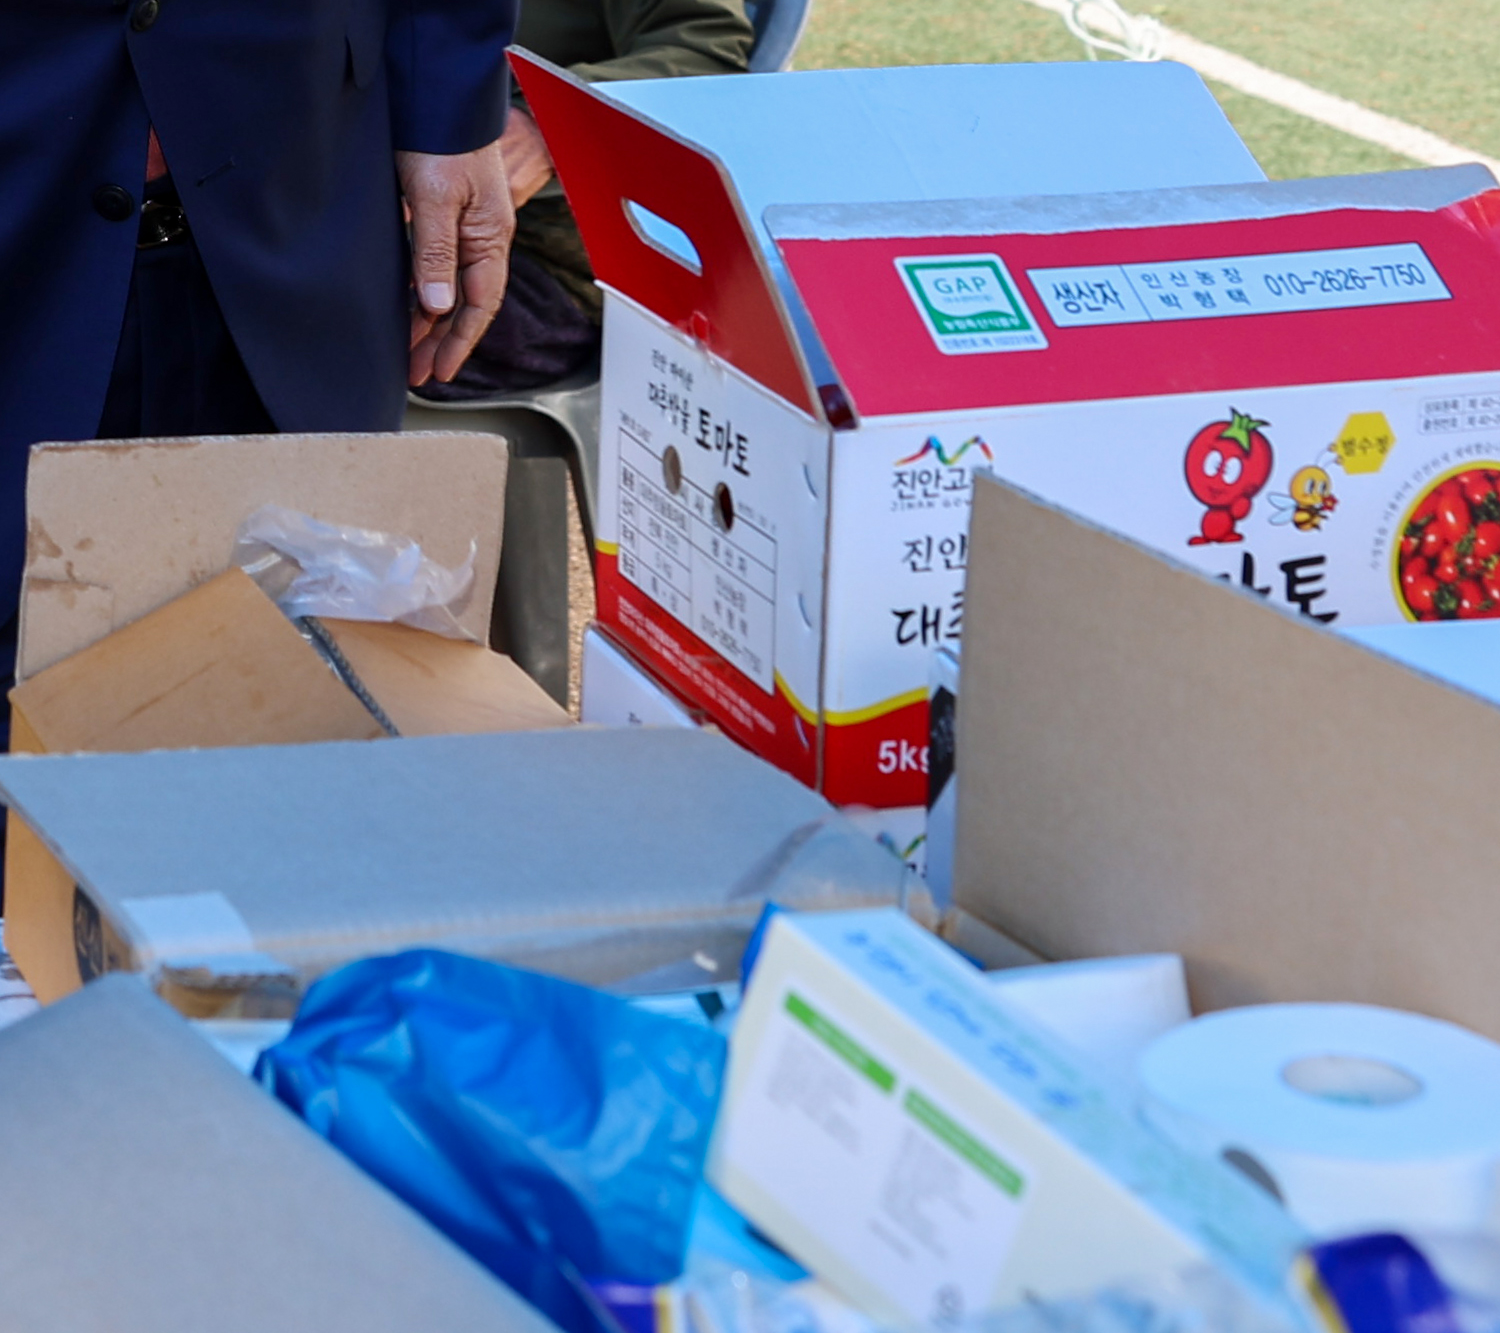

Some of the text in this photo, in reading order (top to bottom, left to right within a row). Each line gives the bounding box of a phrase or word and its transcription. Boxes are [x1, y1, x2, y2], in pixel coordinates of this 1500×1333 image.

[933, 276, 987, 294] GAP
[1140, 267, 1244, 290] 인산농장
[1264, 263, 1426, 296] 010-2626-7750
[1052, 279, 1126, 314] 생산자
[695, 406, 751, 477] 토마토
[892, 467, 972, 500] 진안고
